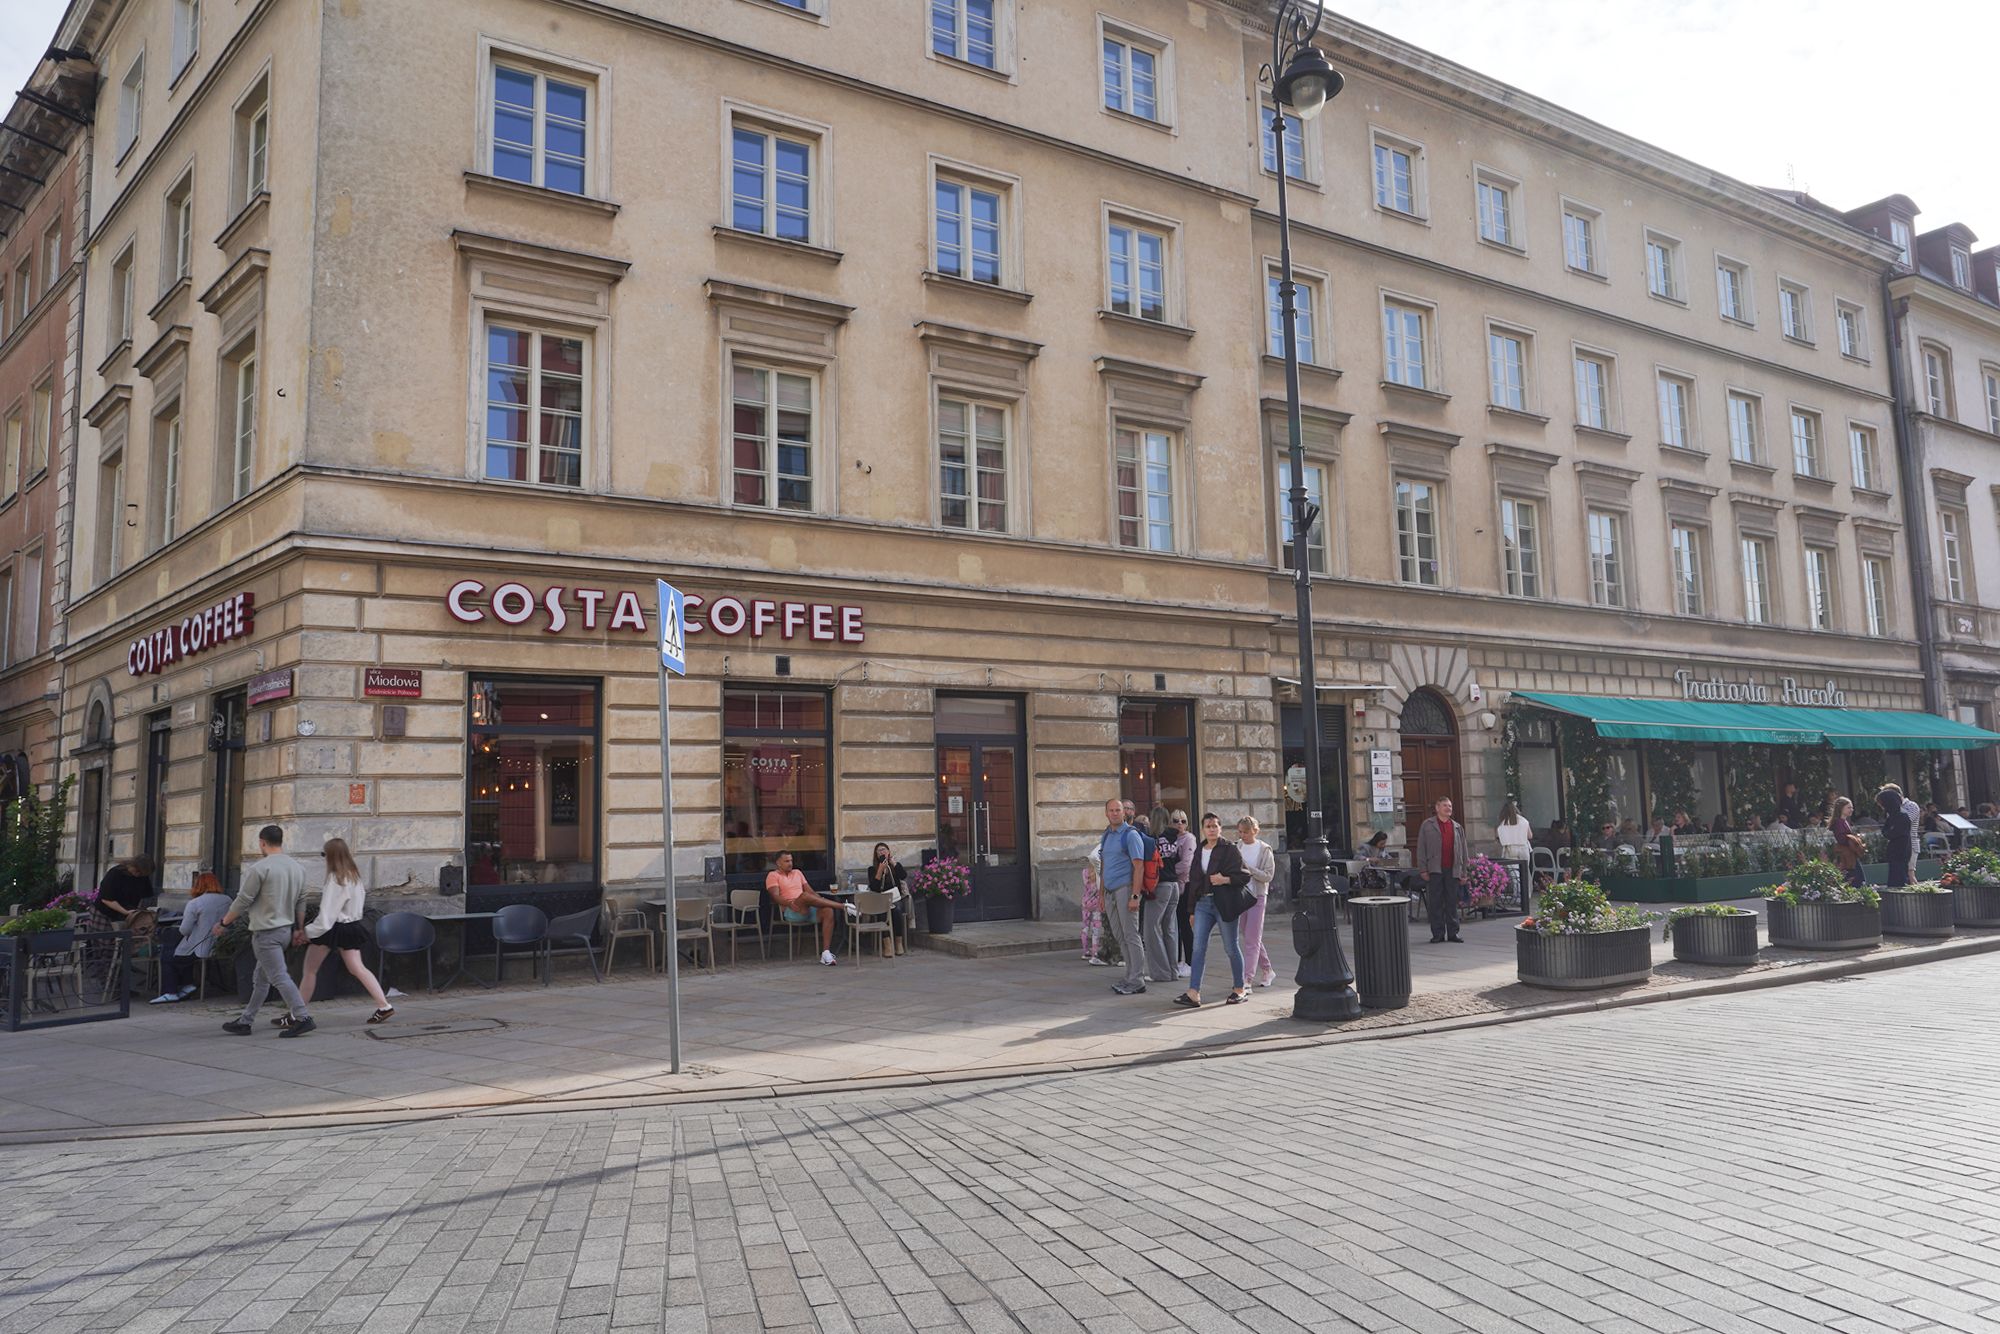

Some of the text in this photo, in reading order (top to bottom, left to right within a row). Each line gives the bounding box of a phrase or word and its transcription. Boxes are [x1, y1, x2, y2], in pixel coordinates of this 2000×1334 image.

[447, 579, 866, 643] COSTA COFFEE
[127, 592, 250, 676] COSTA COFFEE
[368, 674, 420, 688] Miodowa
[1674, 668, 1849, 707] Trattoria Rucola
[751, 757, 788, 768] COSTA
